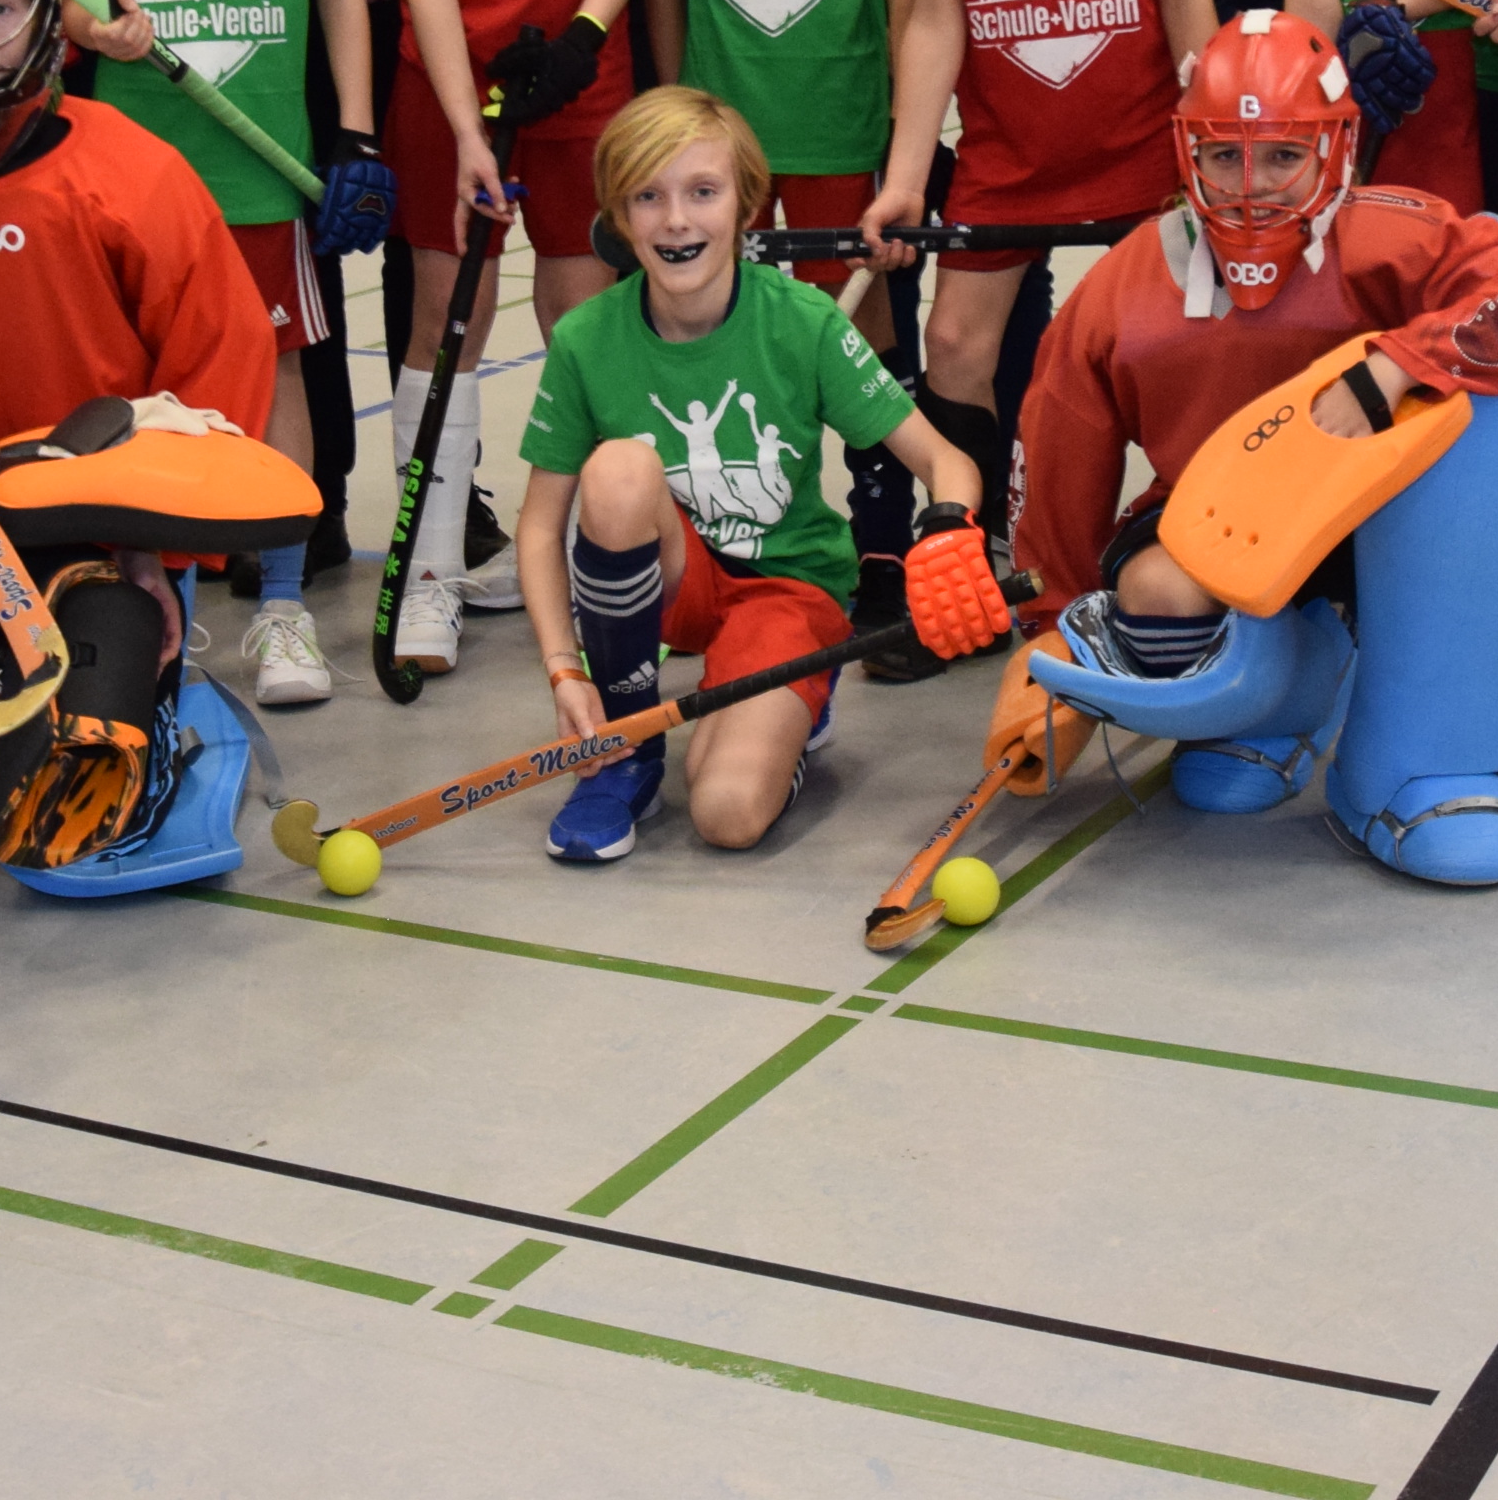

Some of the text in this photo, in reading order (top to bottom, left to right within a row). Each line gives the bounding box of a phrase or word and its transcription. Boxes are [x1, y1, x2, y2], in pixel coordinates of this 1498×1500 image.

[145, 1, 286, 39] hule+Verein
[1226, 262, 1278, 286] OBO
[1243, 405, 1295, 452] OBO
[392, 457, 424, 543] OSAKA
[441, 733, 627, 814] Sport-Möller
[374, 815, 418, 839] indoor
